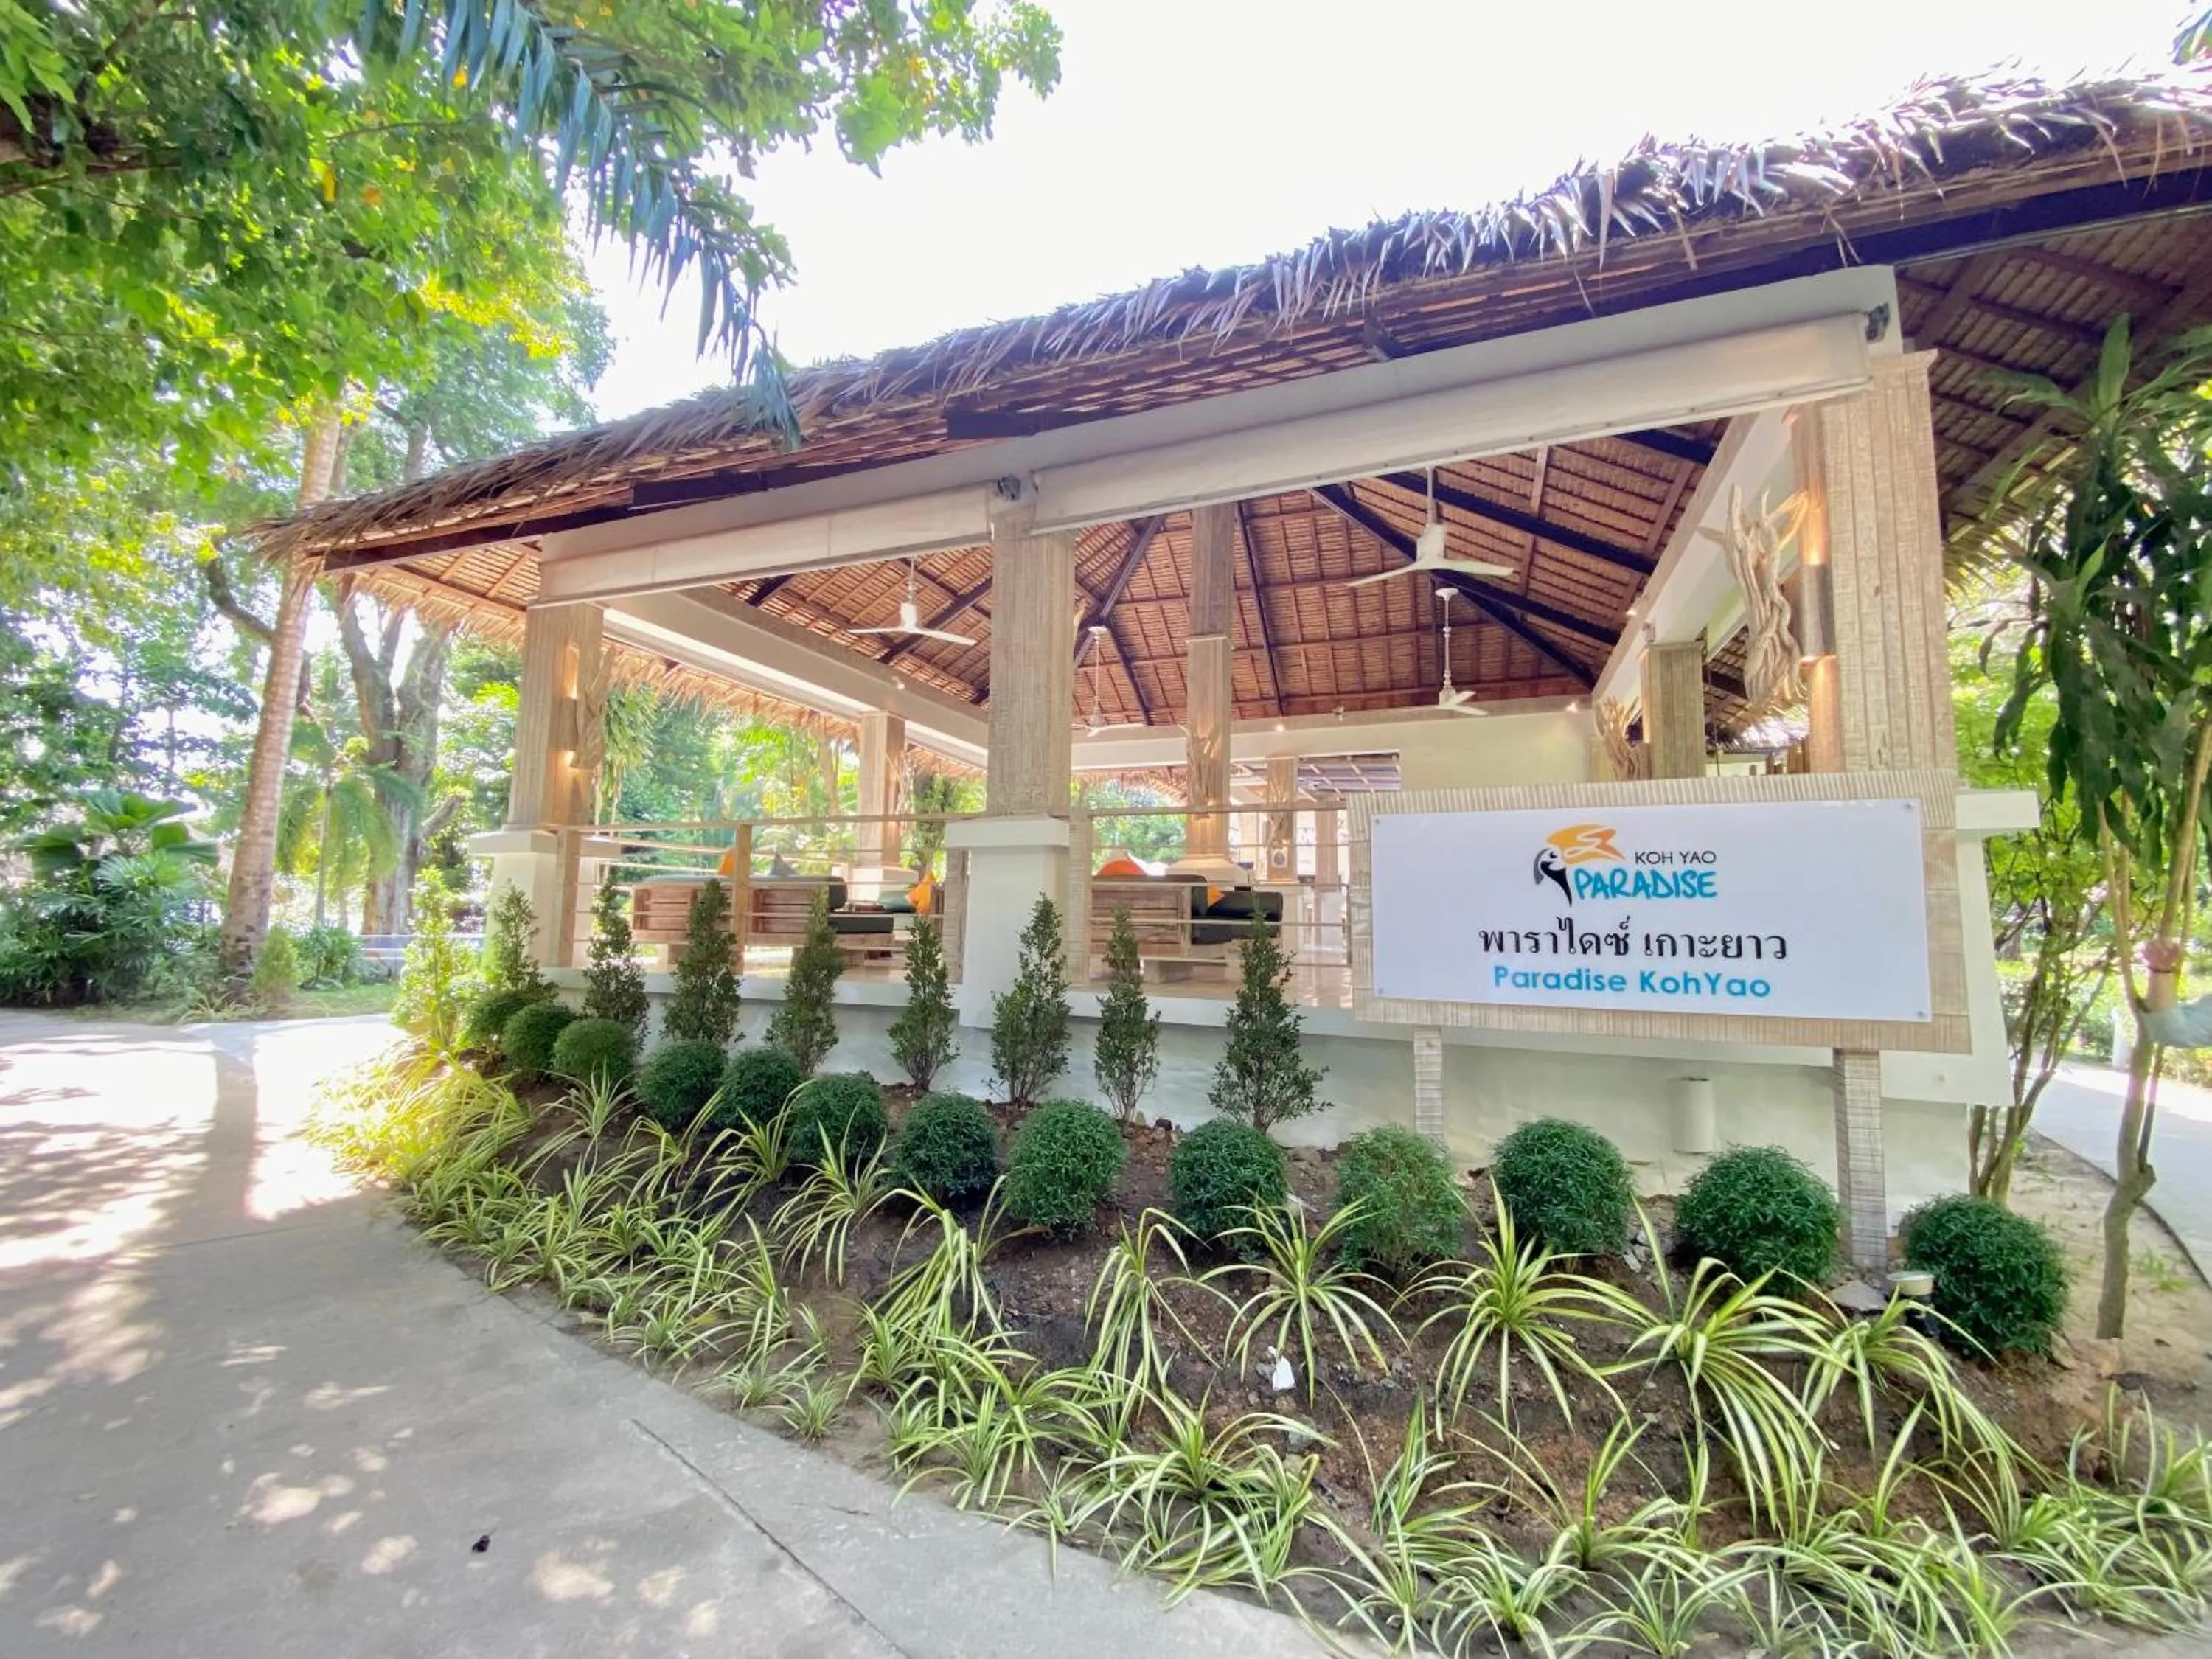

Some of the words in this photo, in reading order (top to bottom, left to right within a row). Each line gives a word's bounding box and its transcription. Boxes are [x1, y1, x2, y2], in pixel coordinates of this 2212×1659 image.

[1635, 851, 1674, 866] KOH
[1679, 850, 1717, 865] YAO
[1574, 866, 1718, 900] PARADISE
[1478, 915, 1631, 956] พาราไดซ์
[1644, 931, 1787, 960] เกาะยาว
[1494, 965, 1627, 992] Paradise
[1638, 970, 1771, 998] KohYao
